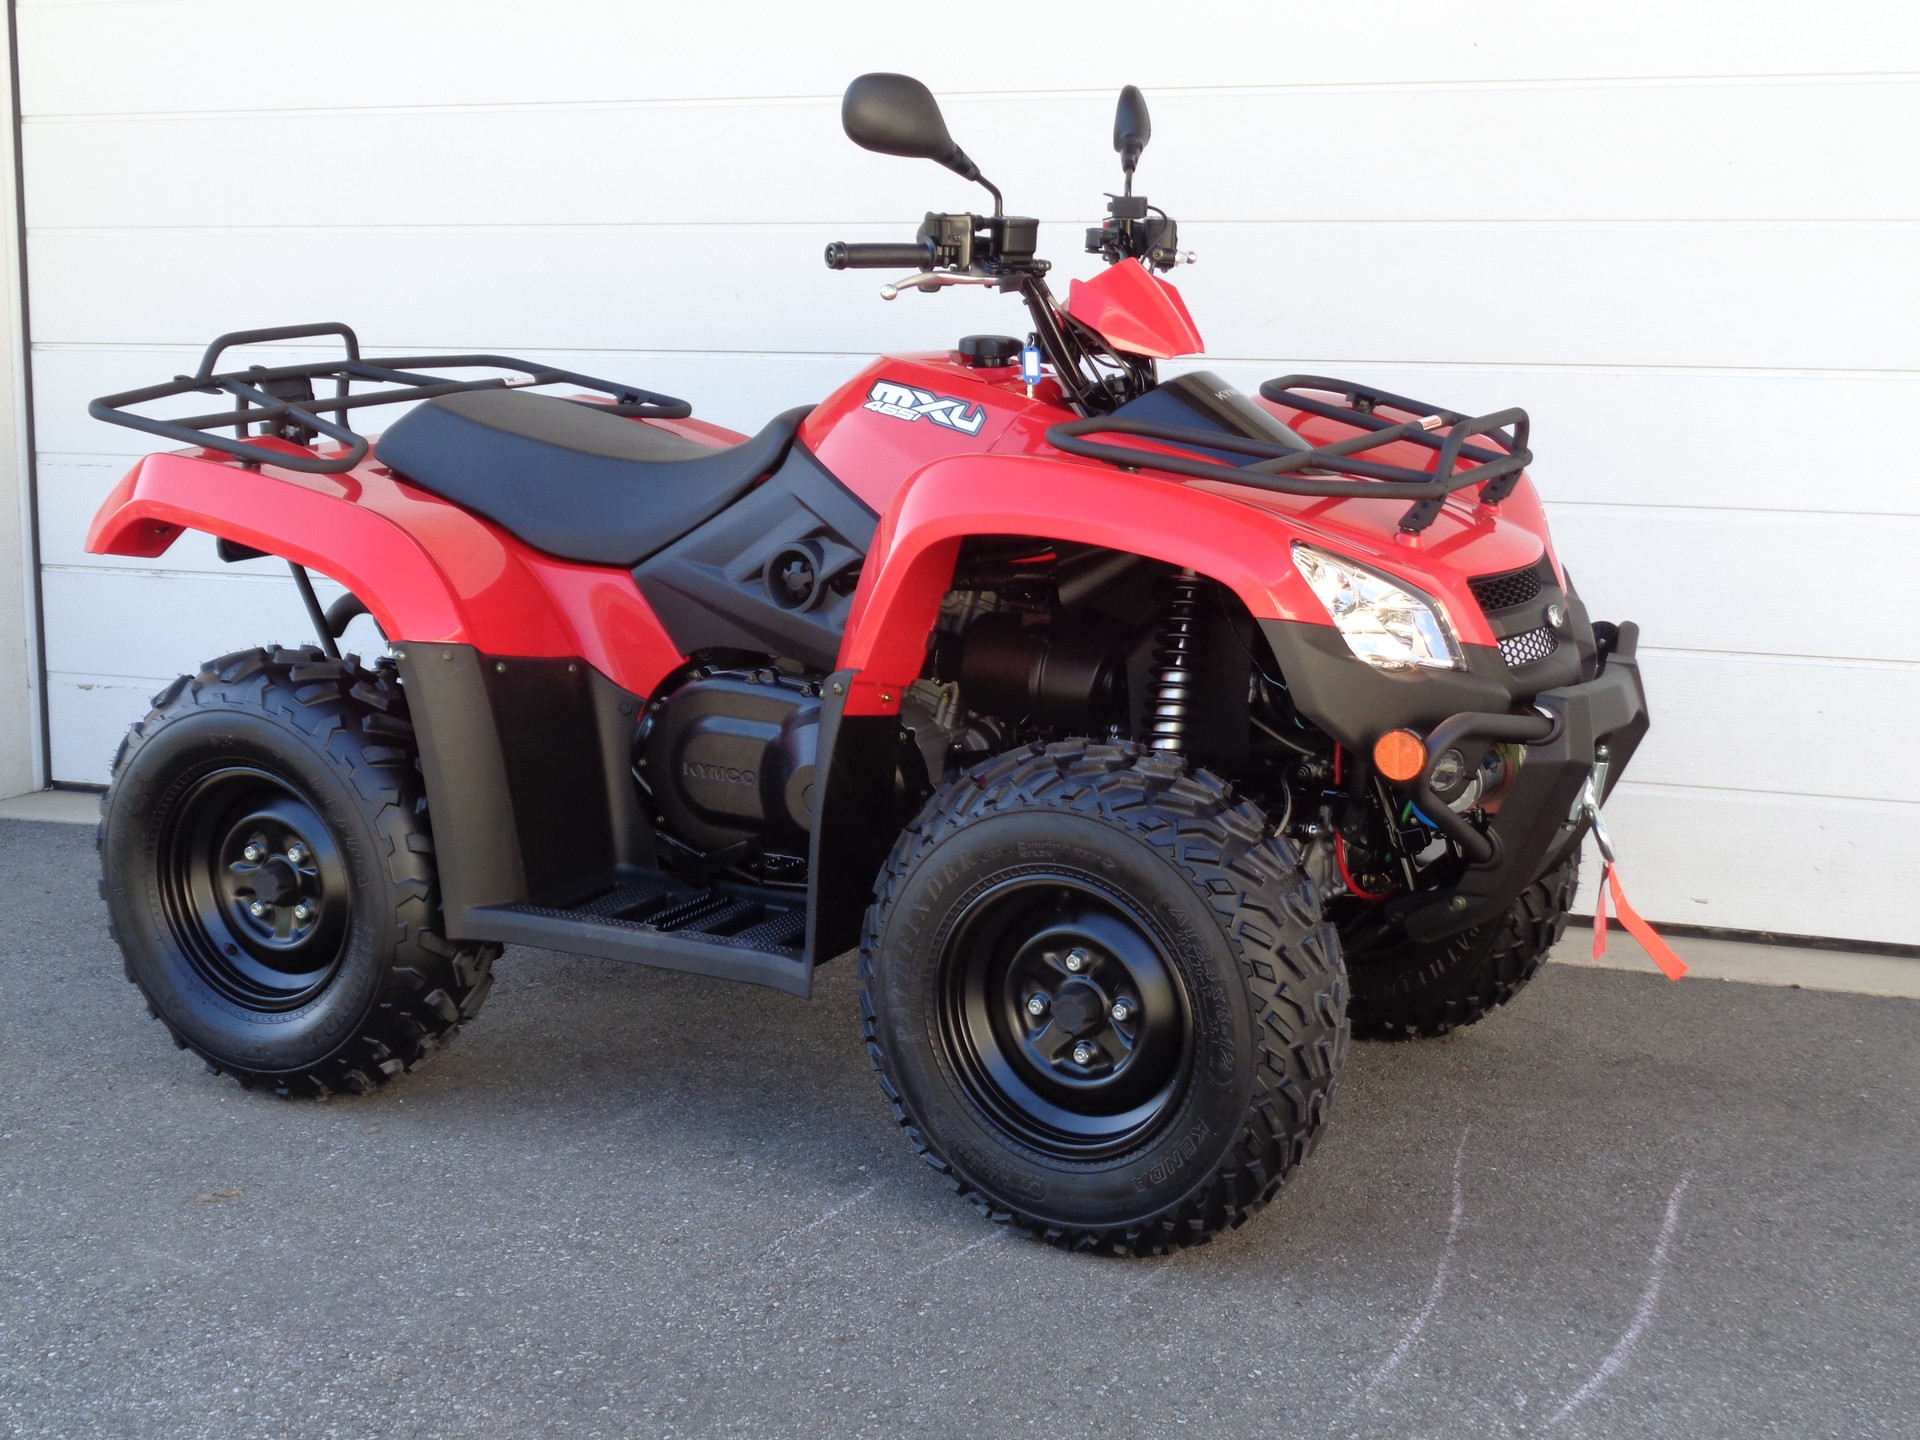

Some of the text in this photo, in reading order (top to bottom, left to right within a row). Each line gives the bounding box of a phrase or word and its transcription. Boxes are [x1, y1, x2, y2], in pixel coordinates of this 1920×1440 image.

[868, 379, 985, 435] MXU
[683, 761, 756, 785] KYMCO
[1129, 1116, 1210, 1193] KENDA
